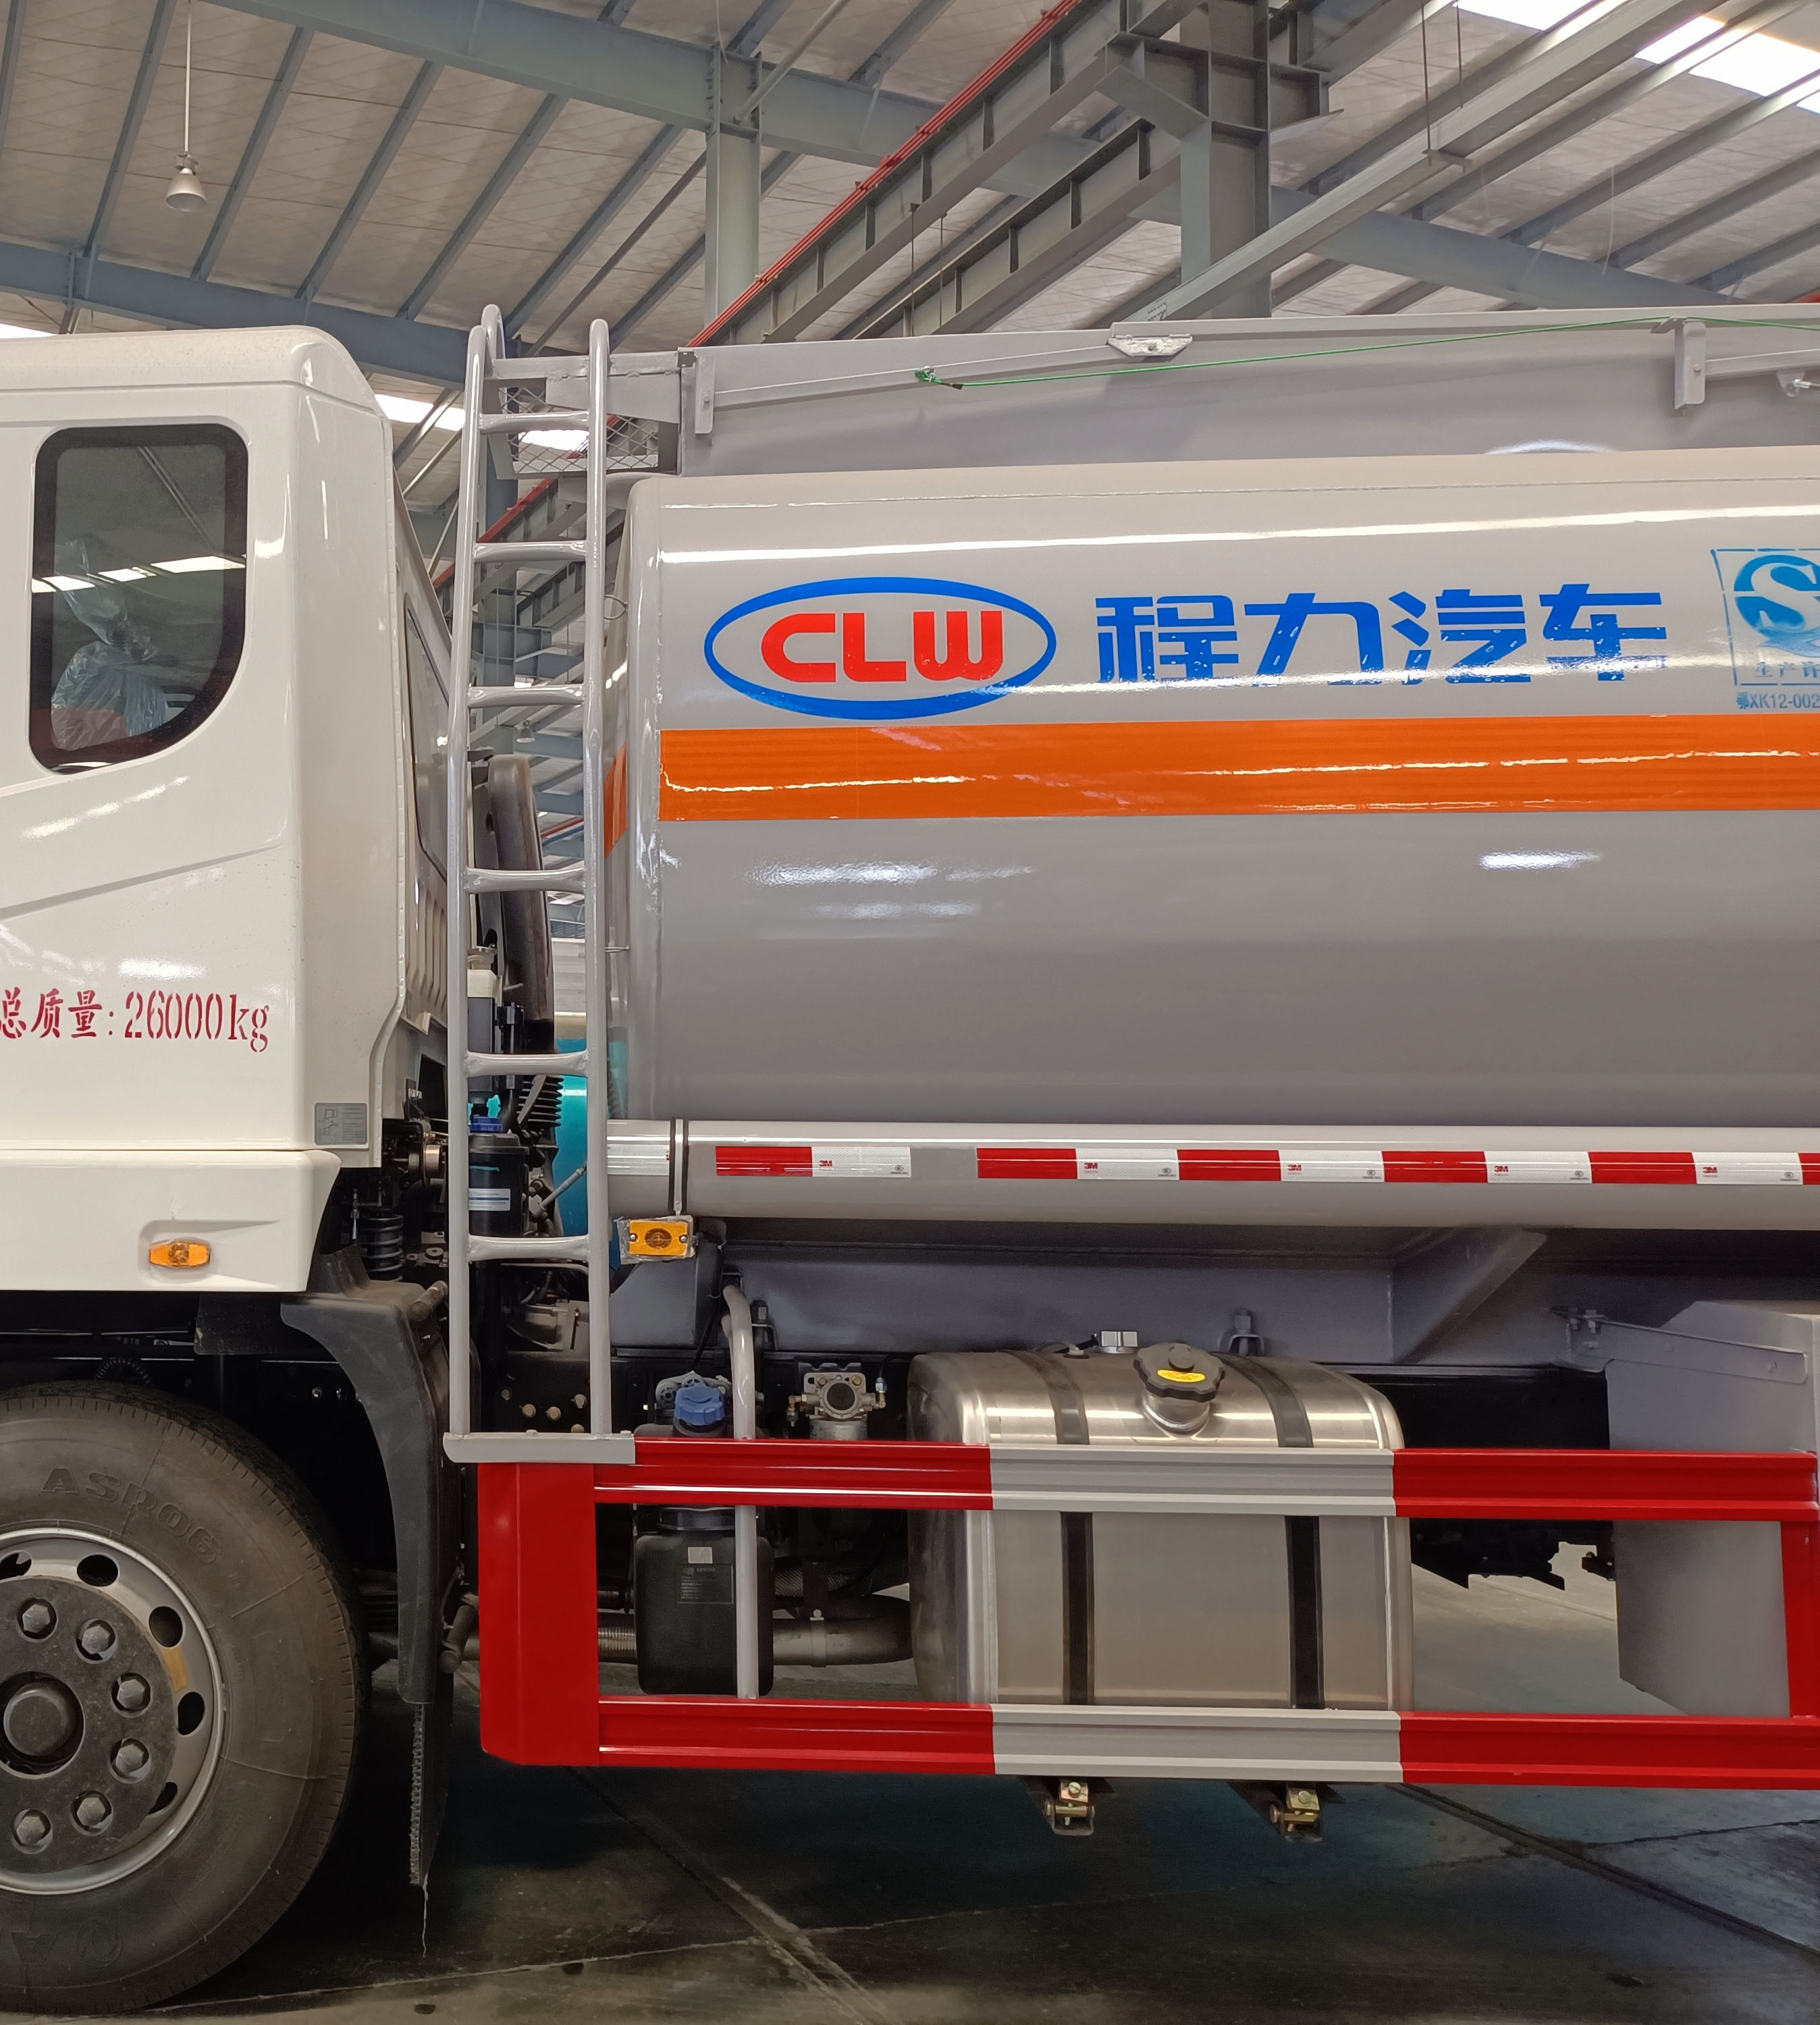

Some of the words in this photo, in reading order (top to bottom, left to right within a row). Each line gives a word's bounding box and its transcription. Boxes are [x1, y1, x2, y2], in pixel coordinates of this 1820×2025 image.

[761, 610, 1004, 683] CLW
[1095, 583, 1668, 686] 程力汽车
